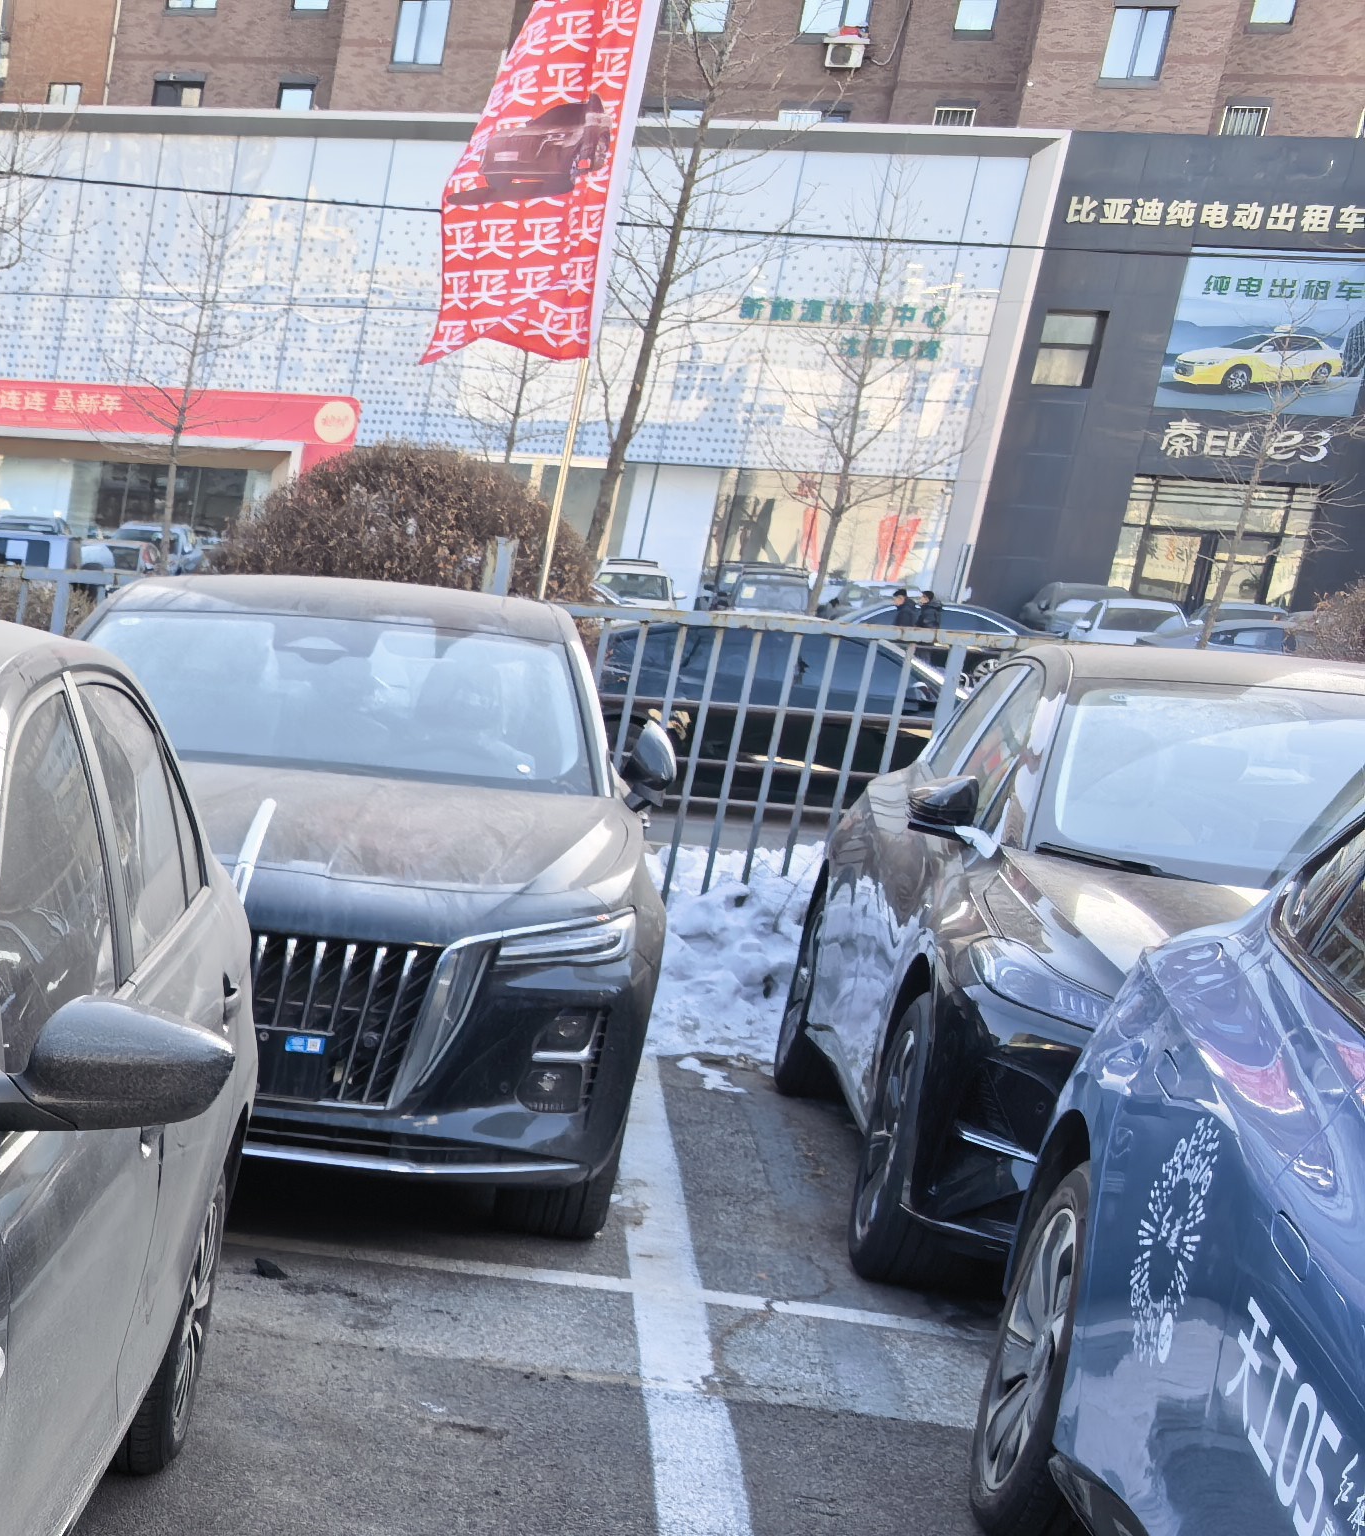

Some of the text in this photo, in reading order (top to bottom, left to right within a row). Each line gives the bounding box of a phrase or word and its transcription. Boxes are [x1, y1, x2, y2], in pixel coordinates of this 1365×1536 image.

[1065, 195, 1365, 234] 比亚迪纯电动出租车
[1201, 274, 1365, 302] 纯电出租车
